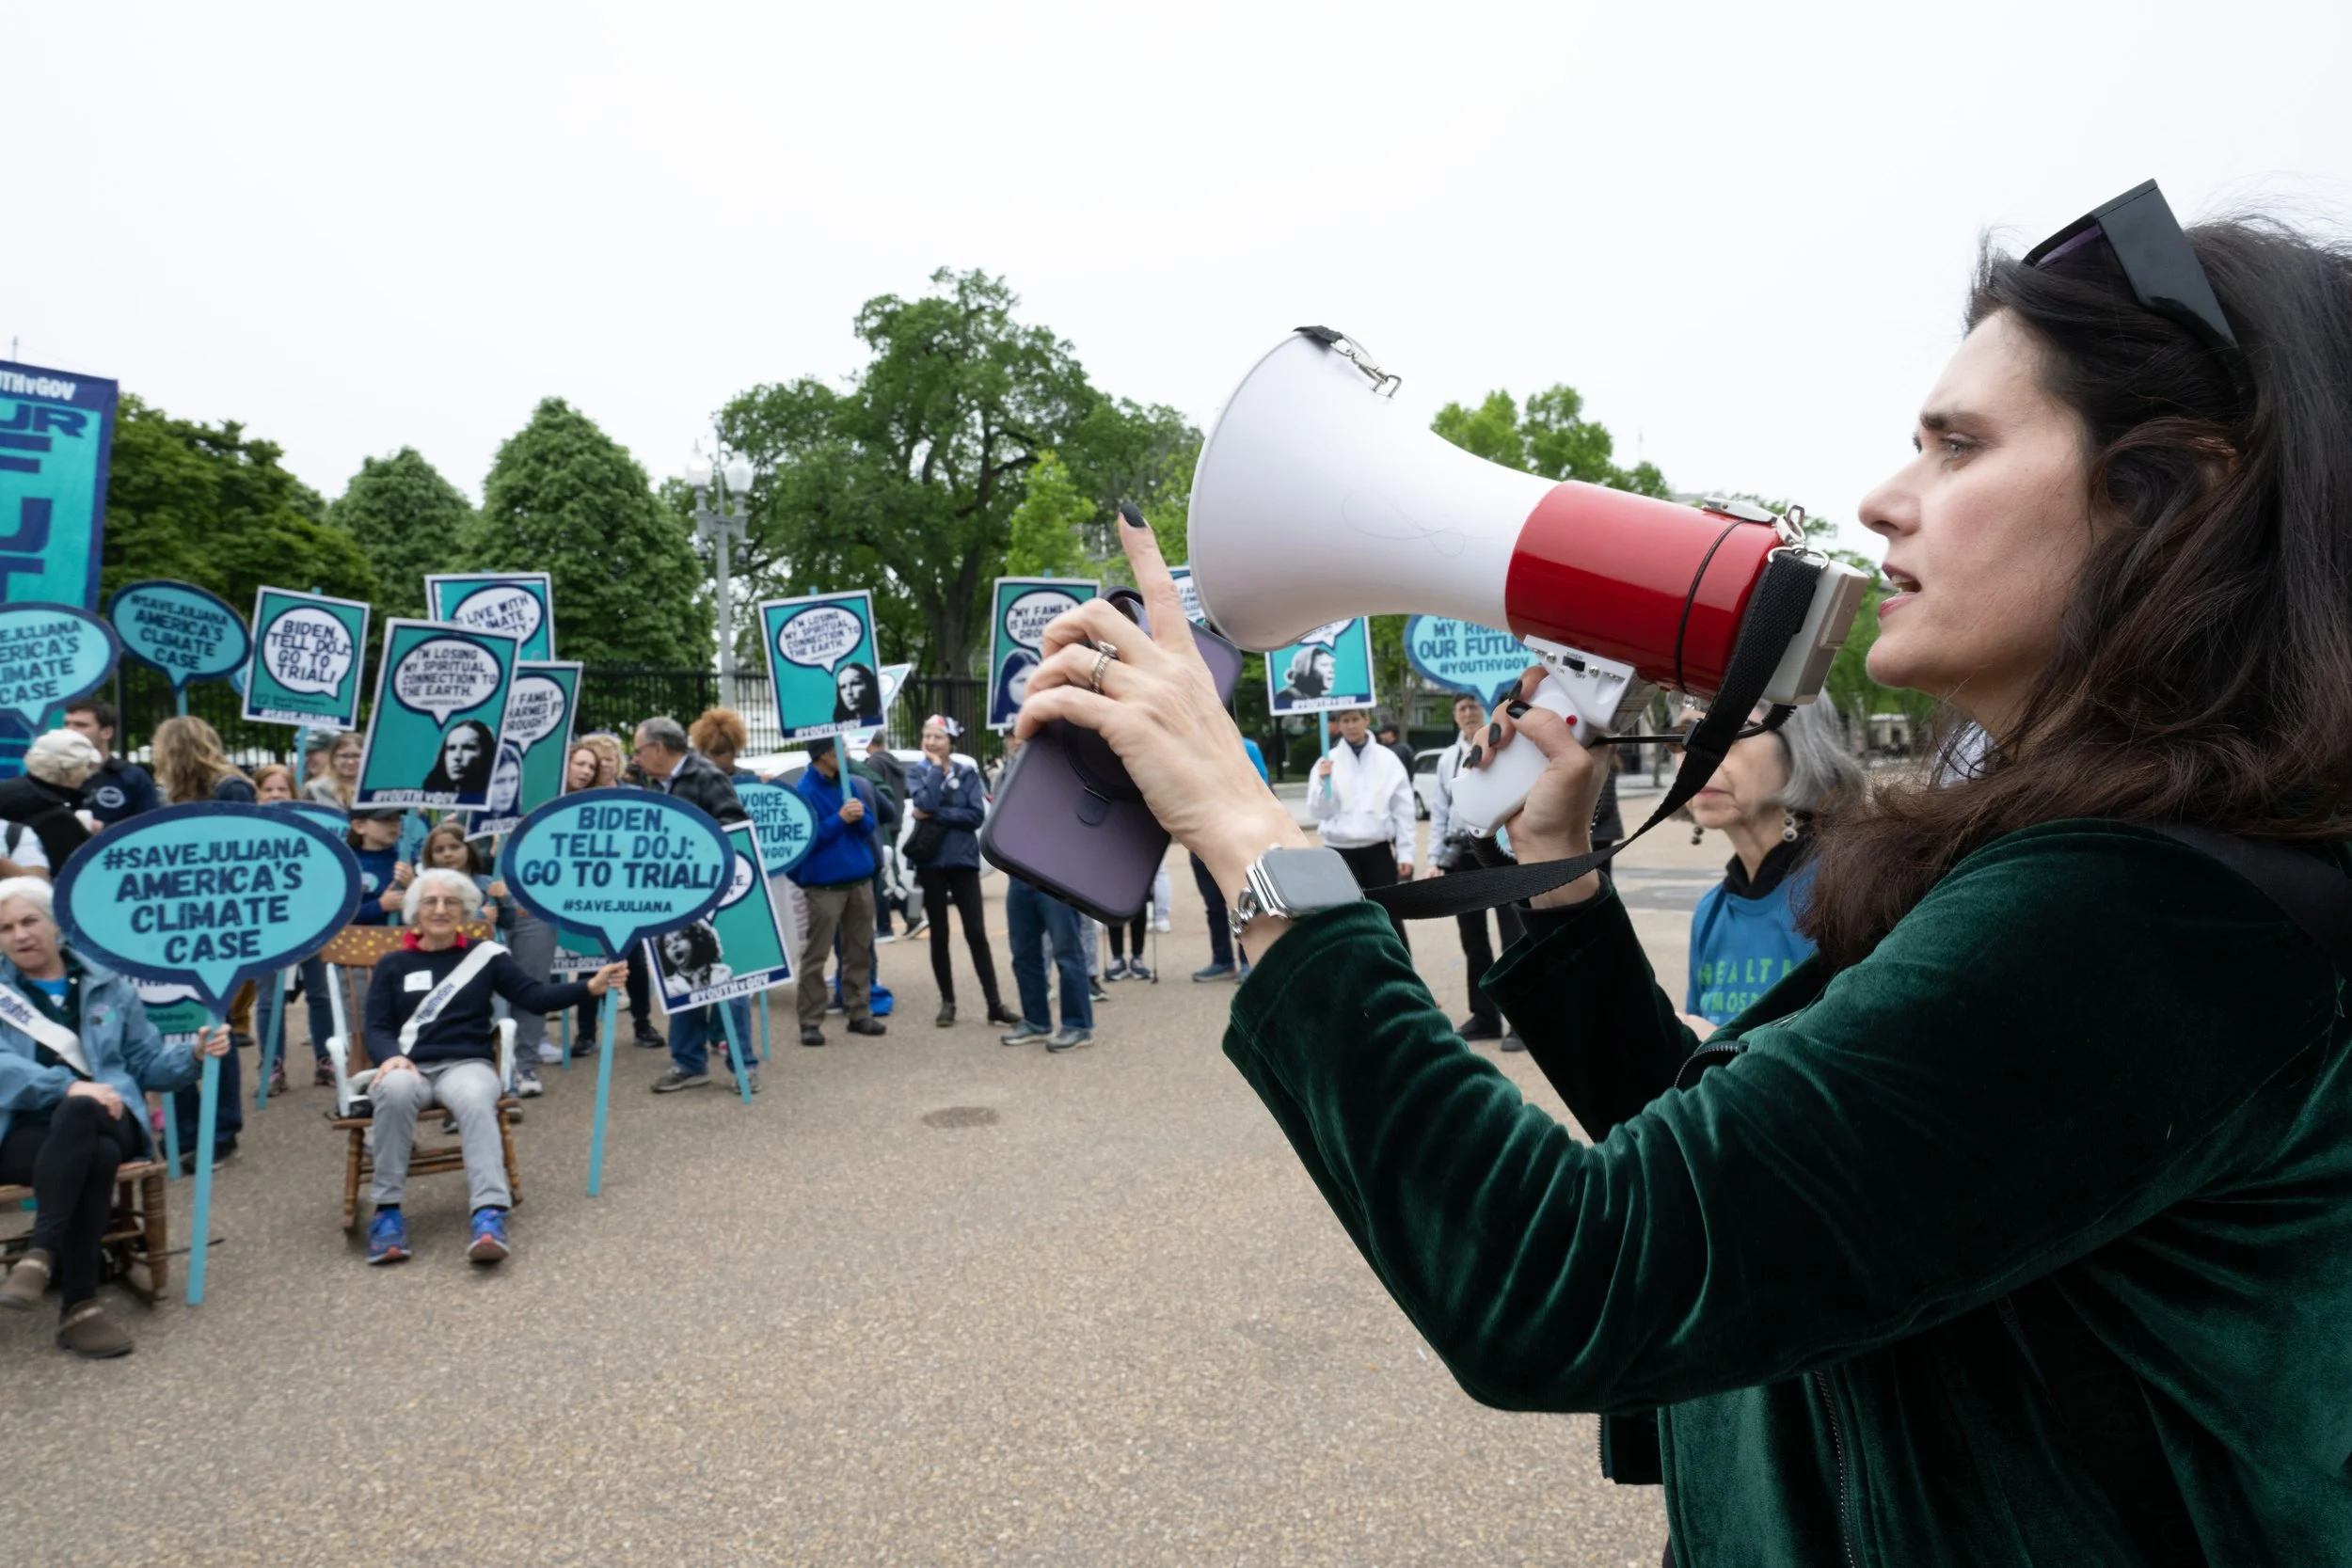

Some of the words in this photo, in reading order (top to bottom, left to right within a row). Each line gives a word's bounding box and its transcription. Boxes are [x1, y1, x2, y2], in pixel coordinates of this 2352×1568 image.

[0, 371, 76, 401] THvGOV
[498, 594, 529, 613] WITH
[135, 610, 224, 642] AMERICA'S
[283, 620, 340, 641] BIDEN,
[1434, 622, 1456, 637] MY
[140, 627, 216, 657] CLIMATE
[268, 631, 310, 651] TELL
[1419, 640, 1457, 659] OUR
[153, 647, 200, 671] CASE
[278, 650, 301, 665] GO
[310, 653, 331, 669] TO
[434, 648, 478, 660] LOSING
[277, 663, 337, 684] TRIAL!
[423, 660, 485, 673] SPIRITUAL
[403, 673, 477, 686] CONNECTION
[0, 680, 58, 705] CASE
[740, 792, 787, 808] VOICE.
[578, 806, 670, 834] BIDEN,
[103, 836, 310, 870] #SAVEJULIANA
[550, 833, 621, 859] TELL
[632, 835, 695, 860] DOJ:
[115, 862, 303, 903] AMERICA'S
[522, 860, 562, 886] GO
[572, 861, 612, 887] TO
[622, 863, 721, 889] TRIAL!
[131, 895, 290, 934] CLIMATE
[564, 899, 673, 913] #SAVEJULIANA
[164, 928, 262, 964] CASE
